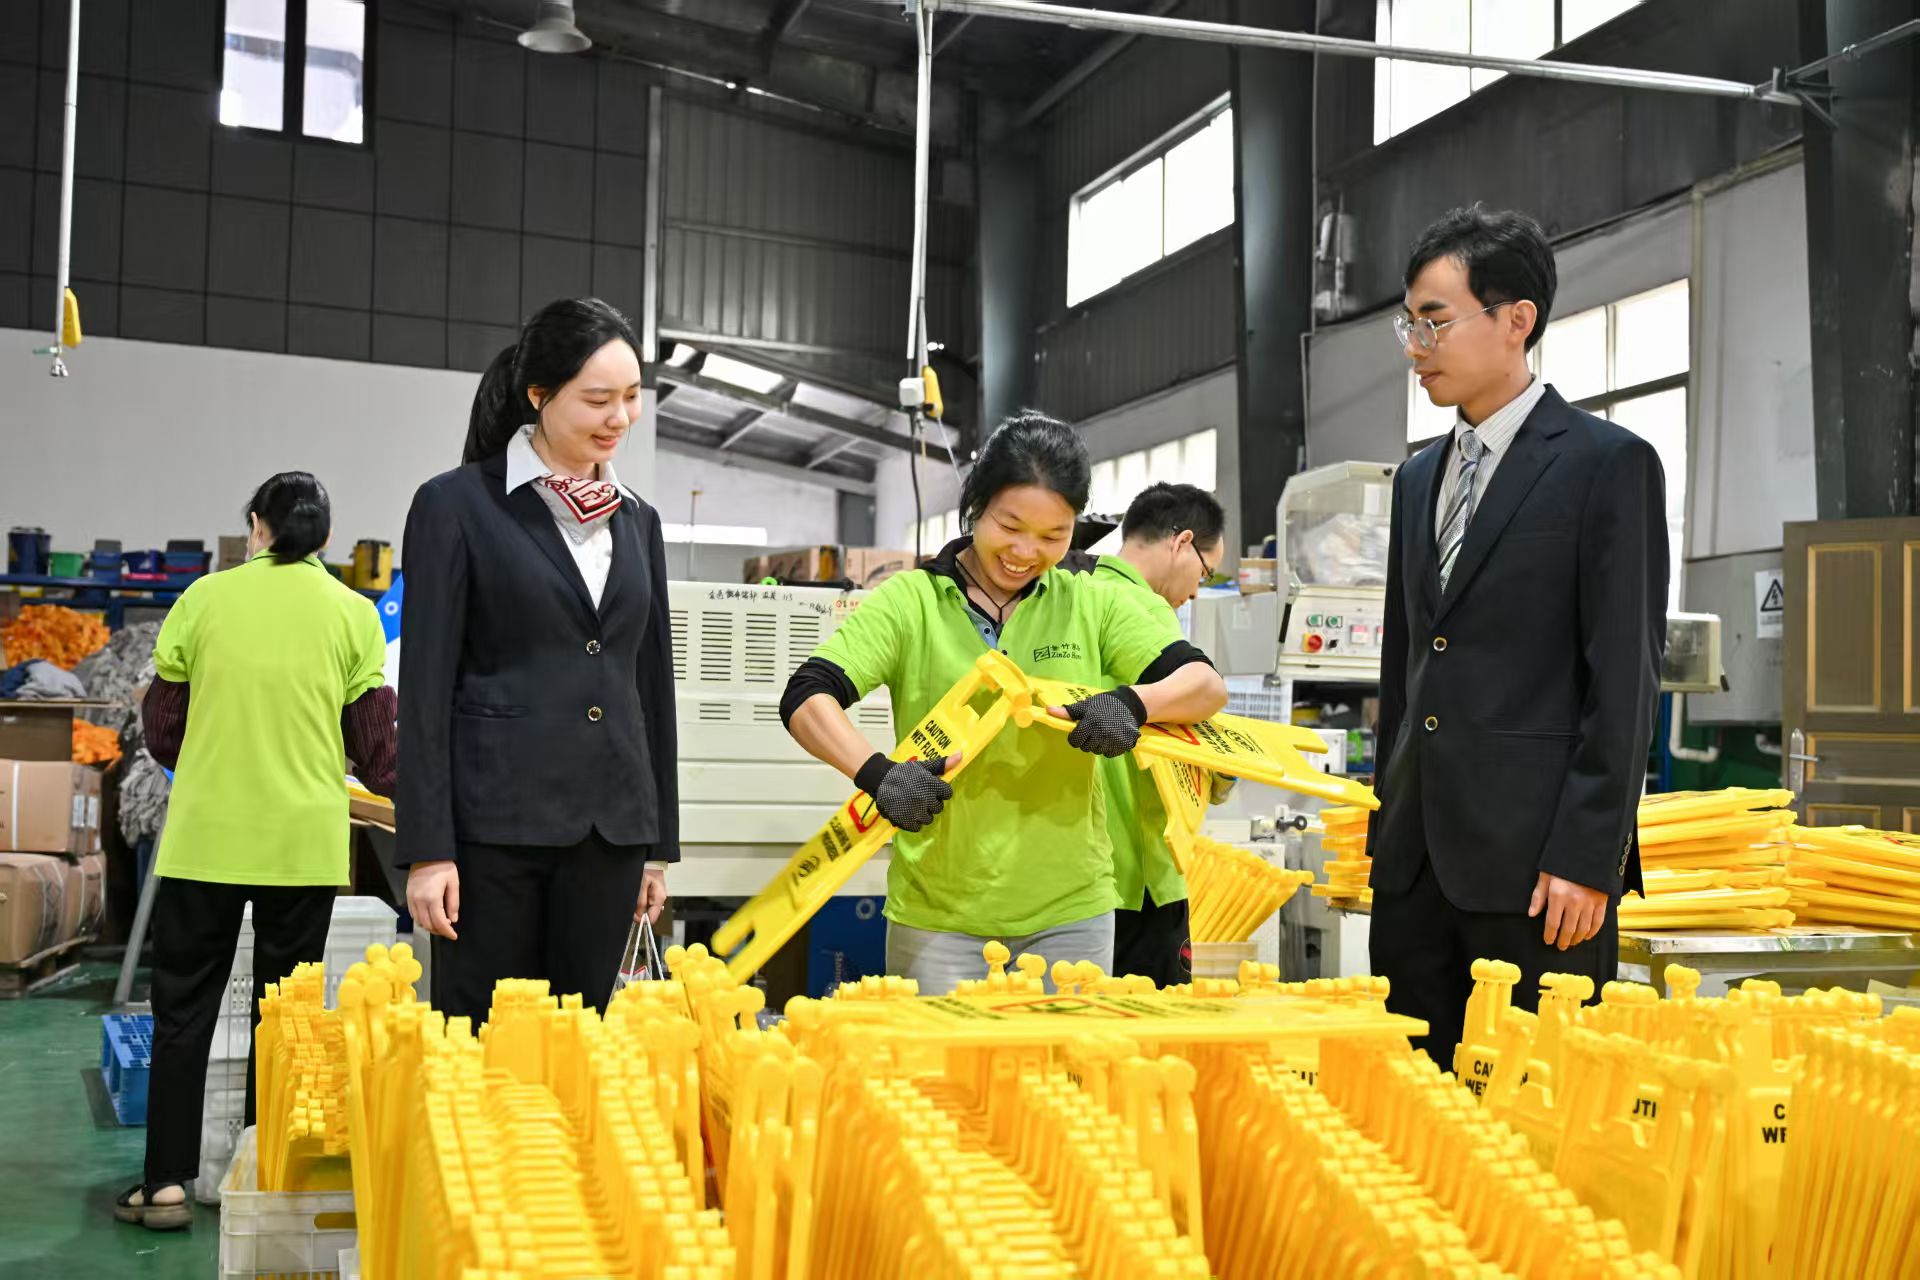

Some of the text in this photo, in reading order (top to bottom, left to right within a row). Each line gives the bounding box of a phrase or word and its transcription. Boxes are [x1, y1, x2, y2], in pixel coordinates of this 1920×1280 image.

[911, 729, 942, 760] WET FLOO
[925, 719, 952, 750] CAUTION
